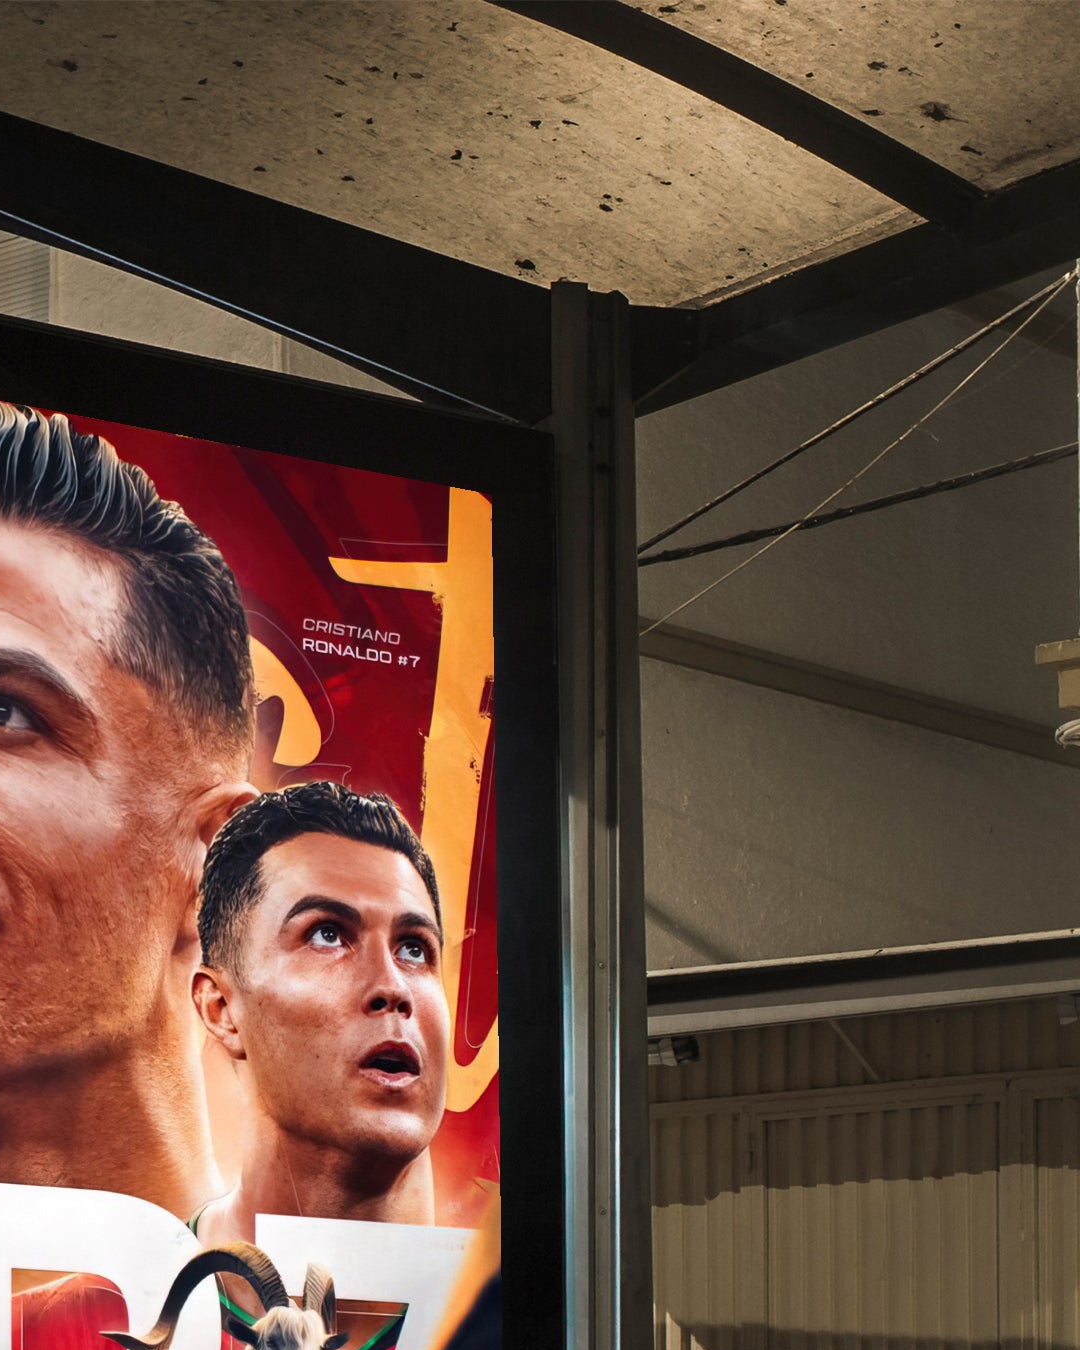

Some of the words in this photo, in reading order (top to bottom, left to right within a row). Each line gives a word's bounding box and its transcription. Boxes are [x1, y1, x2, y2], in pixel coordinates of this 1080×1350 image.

[302, 618, 401, 645] CRISTIANO
[302, 638, 392, 664] RONALDO
[397, 655, 421, 668] #7
